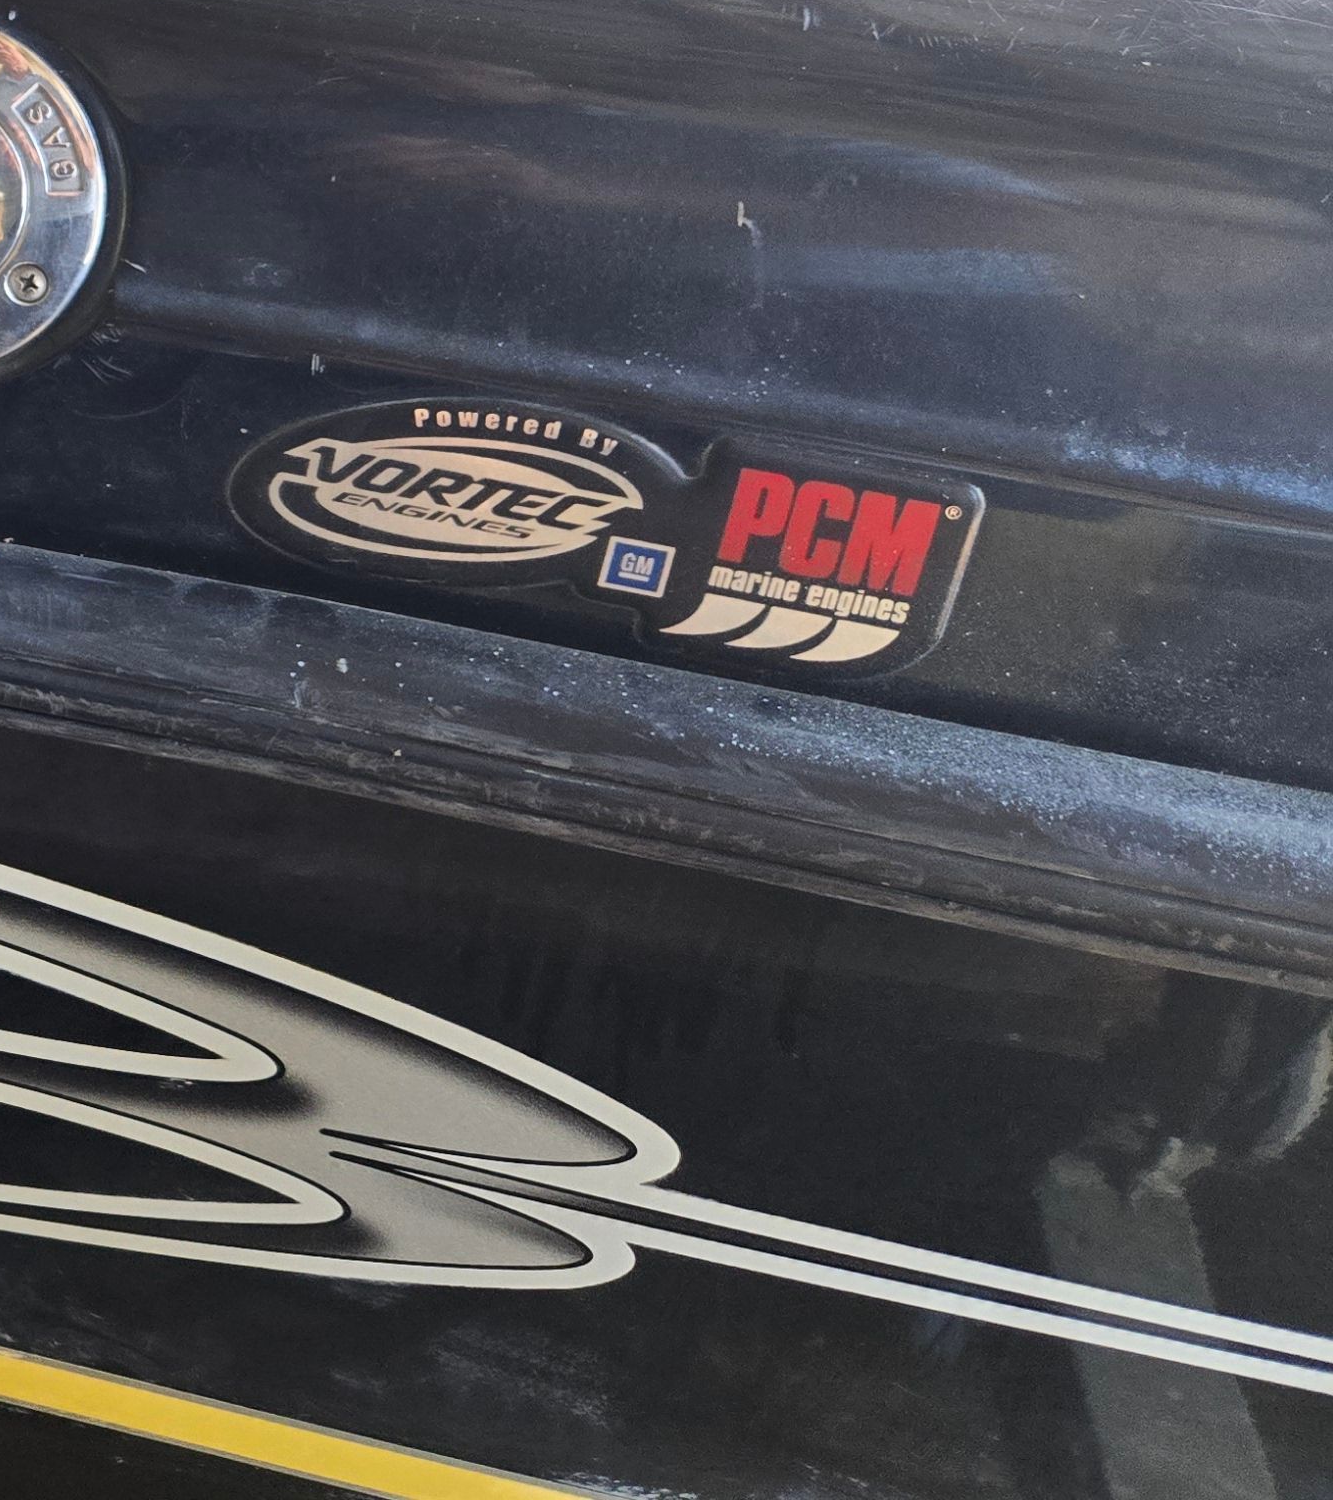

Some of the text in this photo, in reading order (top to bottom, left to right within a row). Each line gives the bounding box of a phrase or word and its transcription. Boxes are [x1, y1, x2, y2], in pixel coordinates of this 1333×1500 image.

[24, 100, 80, 181] GAS
[413, 407, 619, 457] Powered By
[311, 445, 605, 531] VORTEC
[331, 491, 536, 539] ENGINES
[619, 551, 655, 575] GM
[707, 565, 912, 624] marine engines
